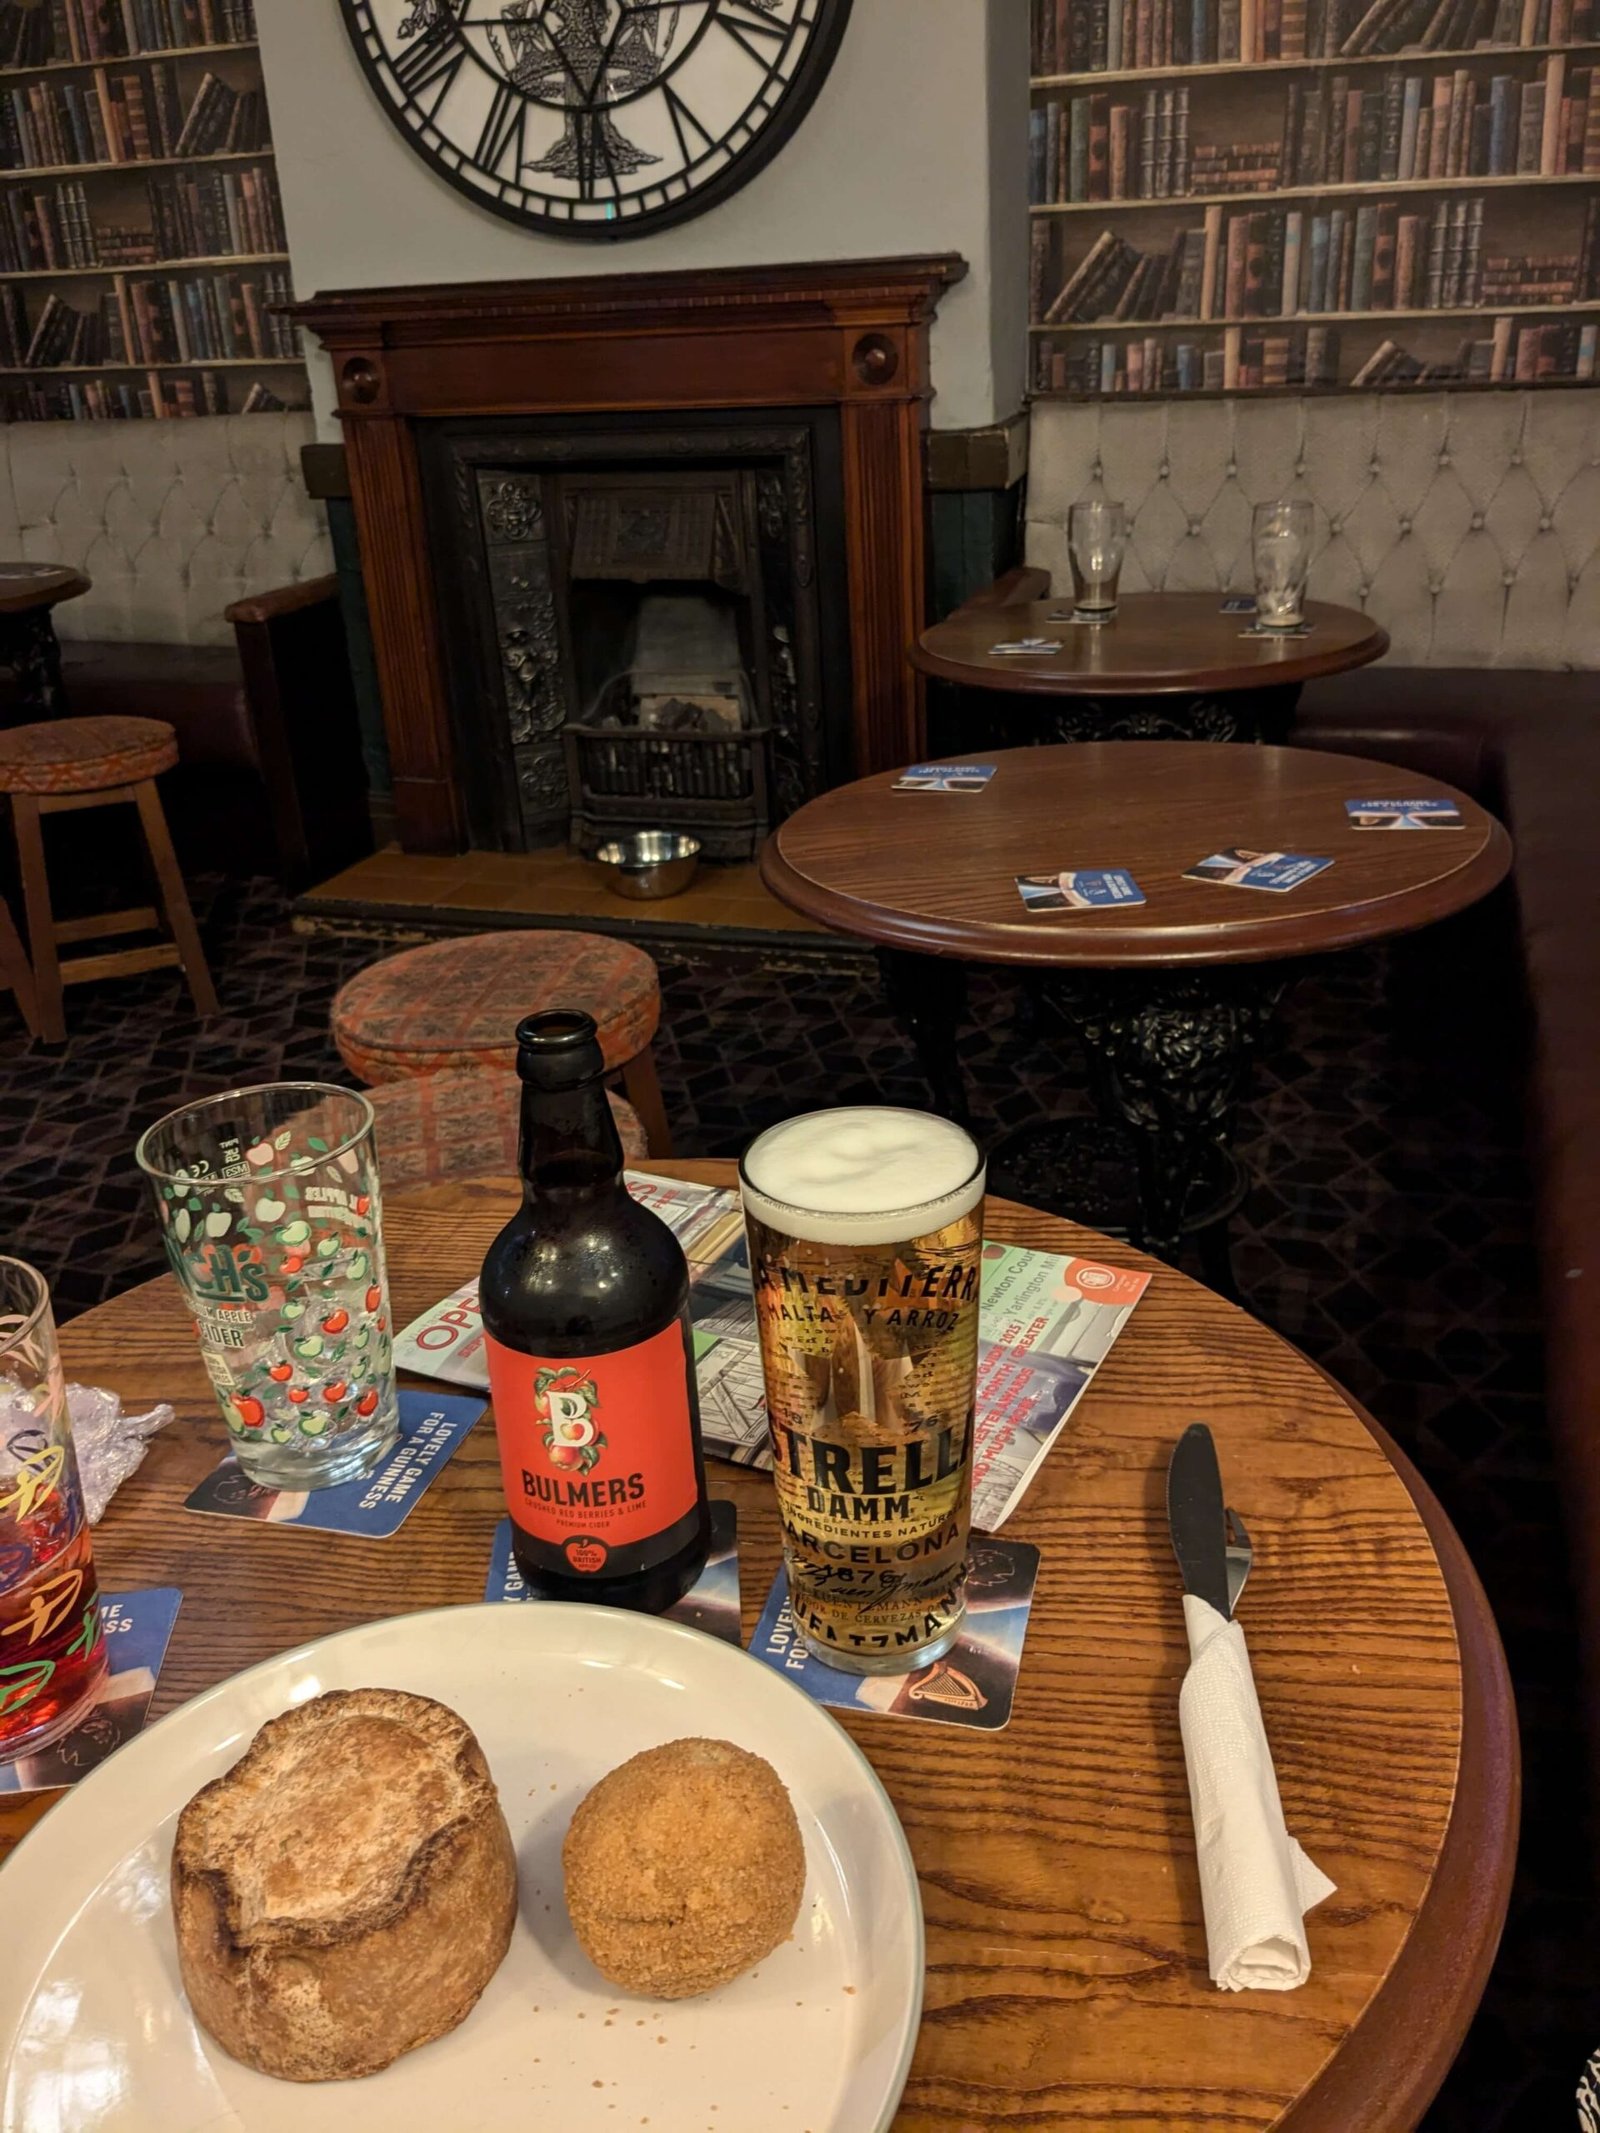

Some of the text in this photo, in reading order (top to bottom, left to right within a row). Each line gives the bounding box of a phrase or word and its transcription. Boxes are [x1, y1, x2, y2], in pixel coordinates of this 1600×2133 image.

[981, 1275, 1016, 1311] Newton
[1003, 1271, 1049, 1315] Yarlington
[217, 1310, 253, 1324] APPLE
[886, 1309, 960, 1331] ARROZ
[999, 1324, 1022, 1344] 2025
[1011, 1316, 1050, 1358] GREATER
[408, 1436, 425, 1444] A
[416, 1412, 445, 1434] FOR
[982, 1425, 1017, 1461] MUCH
[359, 1447, 418, 1509] GUINNESS
[384, 1422, 458, 1503] LOVELY GAME
[521, 1469, 645, 1508] BULMERS
[807, 1487, 911, 1522] DAMM
[556, 1520, 611, 1529] PREMIUM CIDER
[559, 1508, 575, 1518] RED
[577, 1508, 615, 1519] BERRIES
[627, 1500, 647, 1513] LIME
[780, 1516, 959, 1566] ARCELONA
